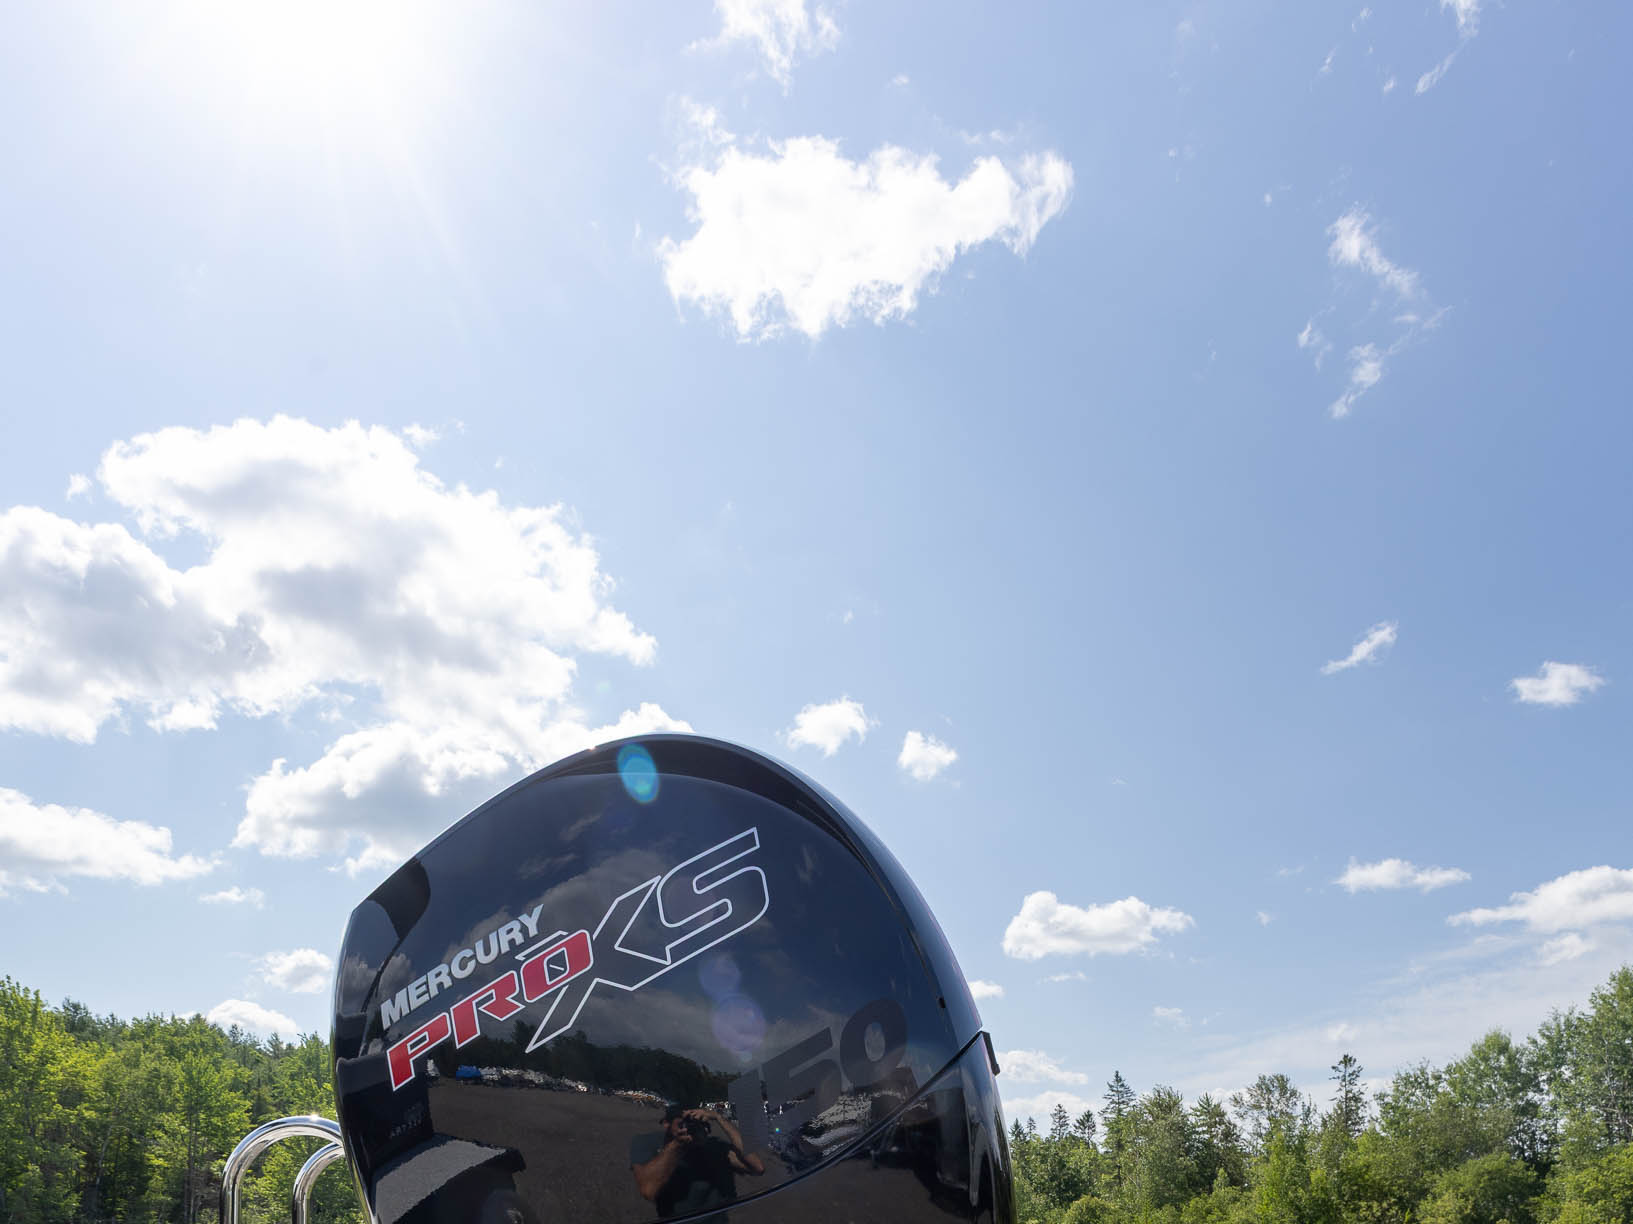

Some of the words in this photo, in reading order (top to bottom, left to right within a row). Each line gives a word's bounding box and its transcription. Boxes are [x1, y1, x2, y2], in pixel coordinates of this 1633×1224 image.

[380, 903, 544, 1031] MERCURY
[386, 929, 594, 1092] PRO
[525, 826, 770, 1054] XS
[728, 999, 908, 1155] 150
